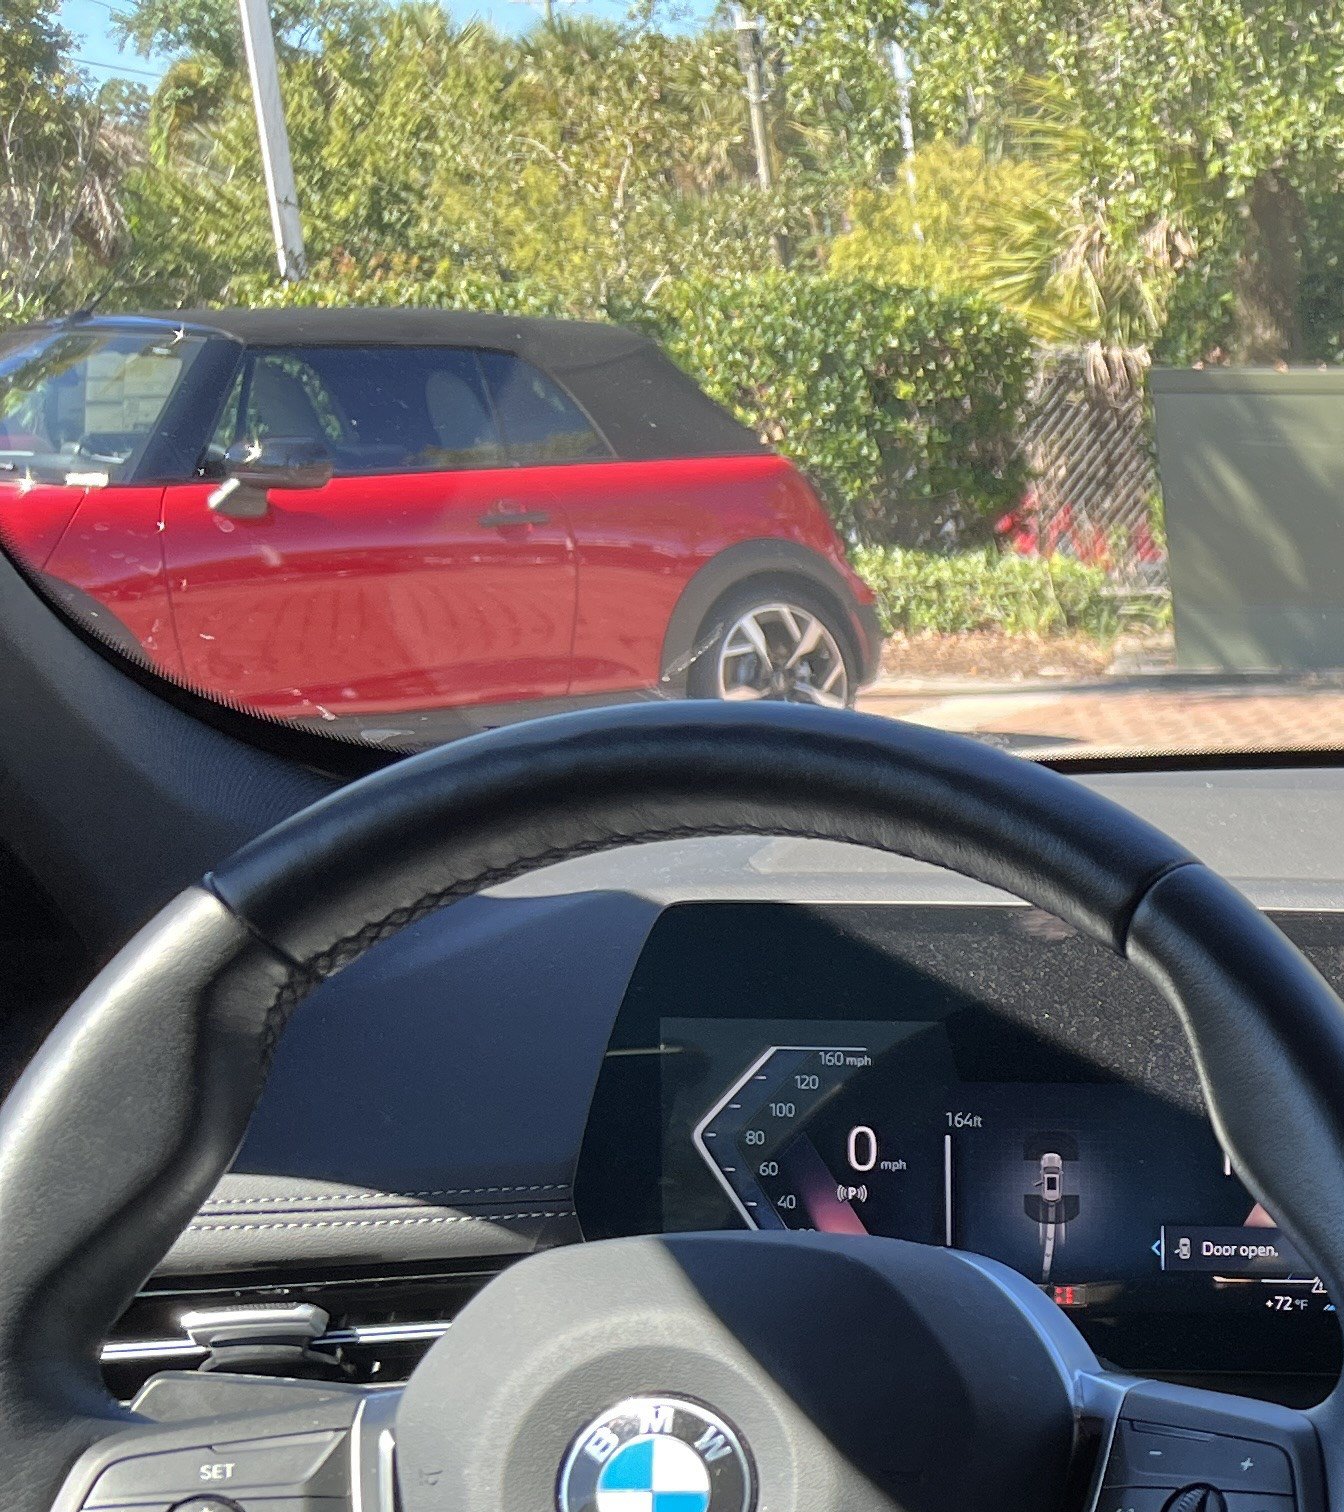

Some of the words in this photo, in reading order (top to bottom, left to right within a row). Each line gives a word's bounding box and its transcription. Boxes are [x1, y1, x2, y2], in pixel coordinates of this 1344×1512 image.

[819, 1051, 844, 1066] 160
[846, 1055, 872, 1068] mph
[794, 1075, 819, 1090] 120
[769, 1102, 796, 1118] 100
[745, 1130, 765, 1145] 80
[847, 1125, 878, 1172] 0
[880, 1159, 907, 1172] mph
[758, 1161, 779, 1176] 60
[777, 1194, 797, 1209] 40
[1201, 1241, 1238, 1256] Door
[1239, 1244, 1279, 1260] open.
[584, 1403, 733, 1464] BMW
[200, 1463, 236, 1480] SET
